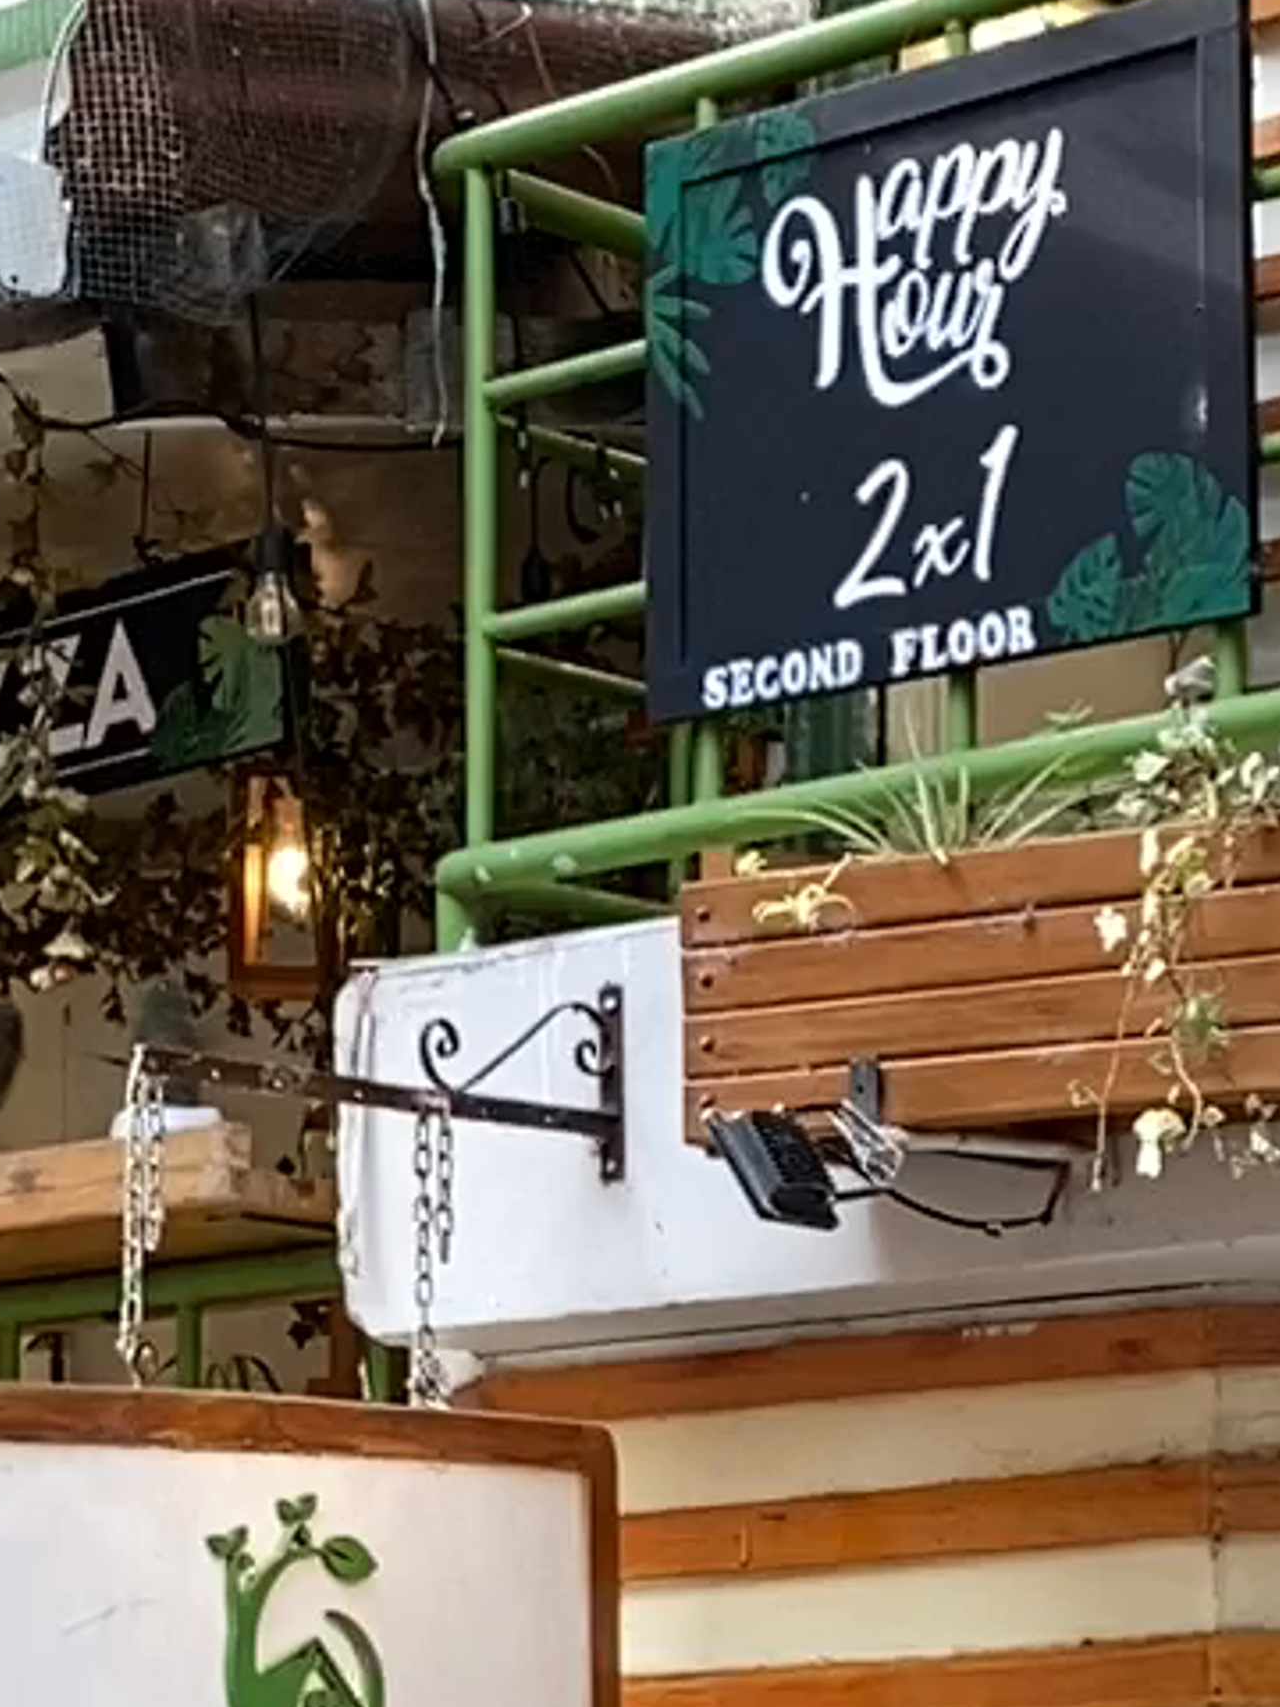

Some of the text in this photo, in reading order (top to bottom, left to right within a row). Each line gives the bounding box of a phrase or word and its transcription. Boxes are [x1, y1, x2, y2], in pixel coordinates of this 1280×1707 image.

[762, 127, 1067, 388] Happy
[702, 606, 1037, 710] SECOND FLOOR
